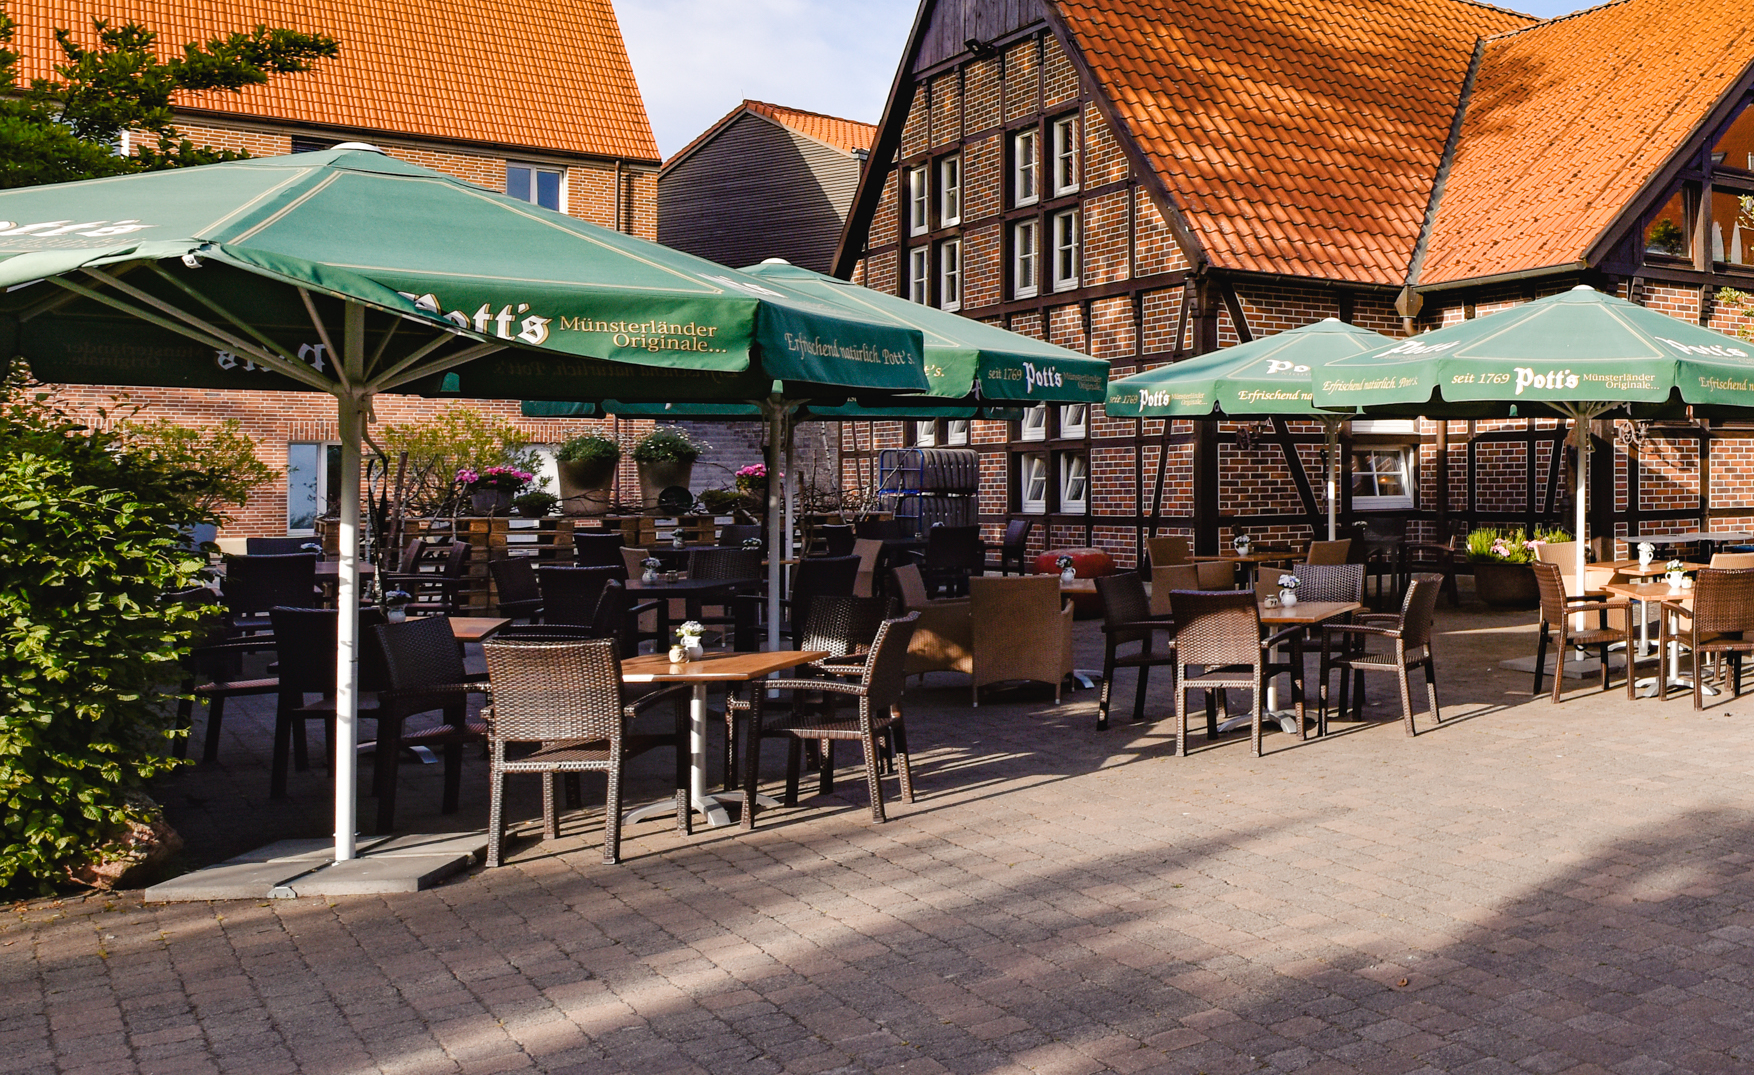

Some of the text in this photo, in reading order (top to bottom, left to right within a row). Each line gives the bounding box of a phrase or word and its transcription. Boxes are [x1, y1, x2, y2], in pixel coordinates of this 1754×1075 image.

[559, 316, 718, 337] Münsterländer
[612, 333, 727, 353] Originale...
[784, 333, 915, 366] Erfrischend natürlich. Pott's.
[988, 361, 1063, 394] seit 1769 Pott's
[1322, 378, 1363, 395] Erfrischend
[1363, 376, 1396, 390] natürlich.
[1451, 366, 1581, 395] seit 1769 Pott's
[1582, 373, 1655, 382] Münsterländer
[1605, 380, 1660, 390] Originale...
[1698, 375, 1747, 393] Erfrischend
[1109, 388, 1171, 413] seit 1769 Pott's
[1238, 389, 1300, 404] Erfrischend
